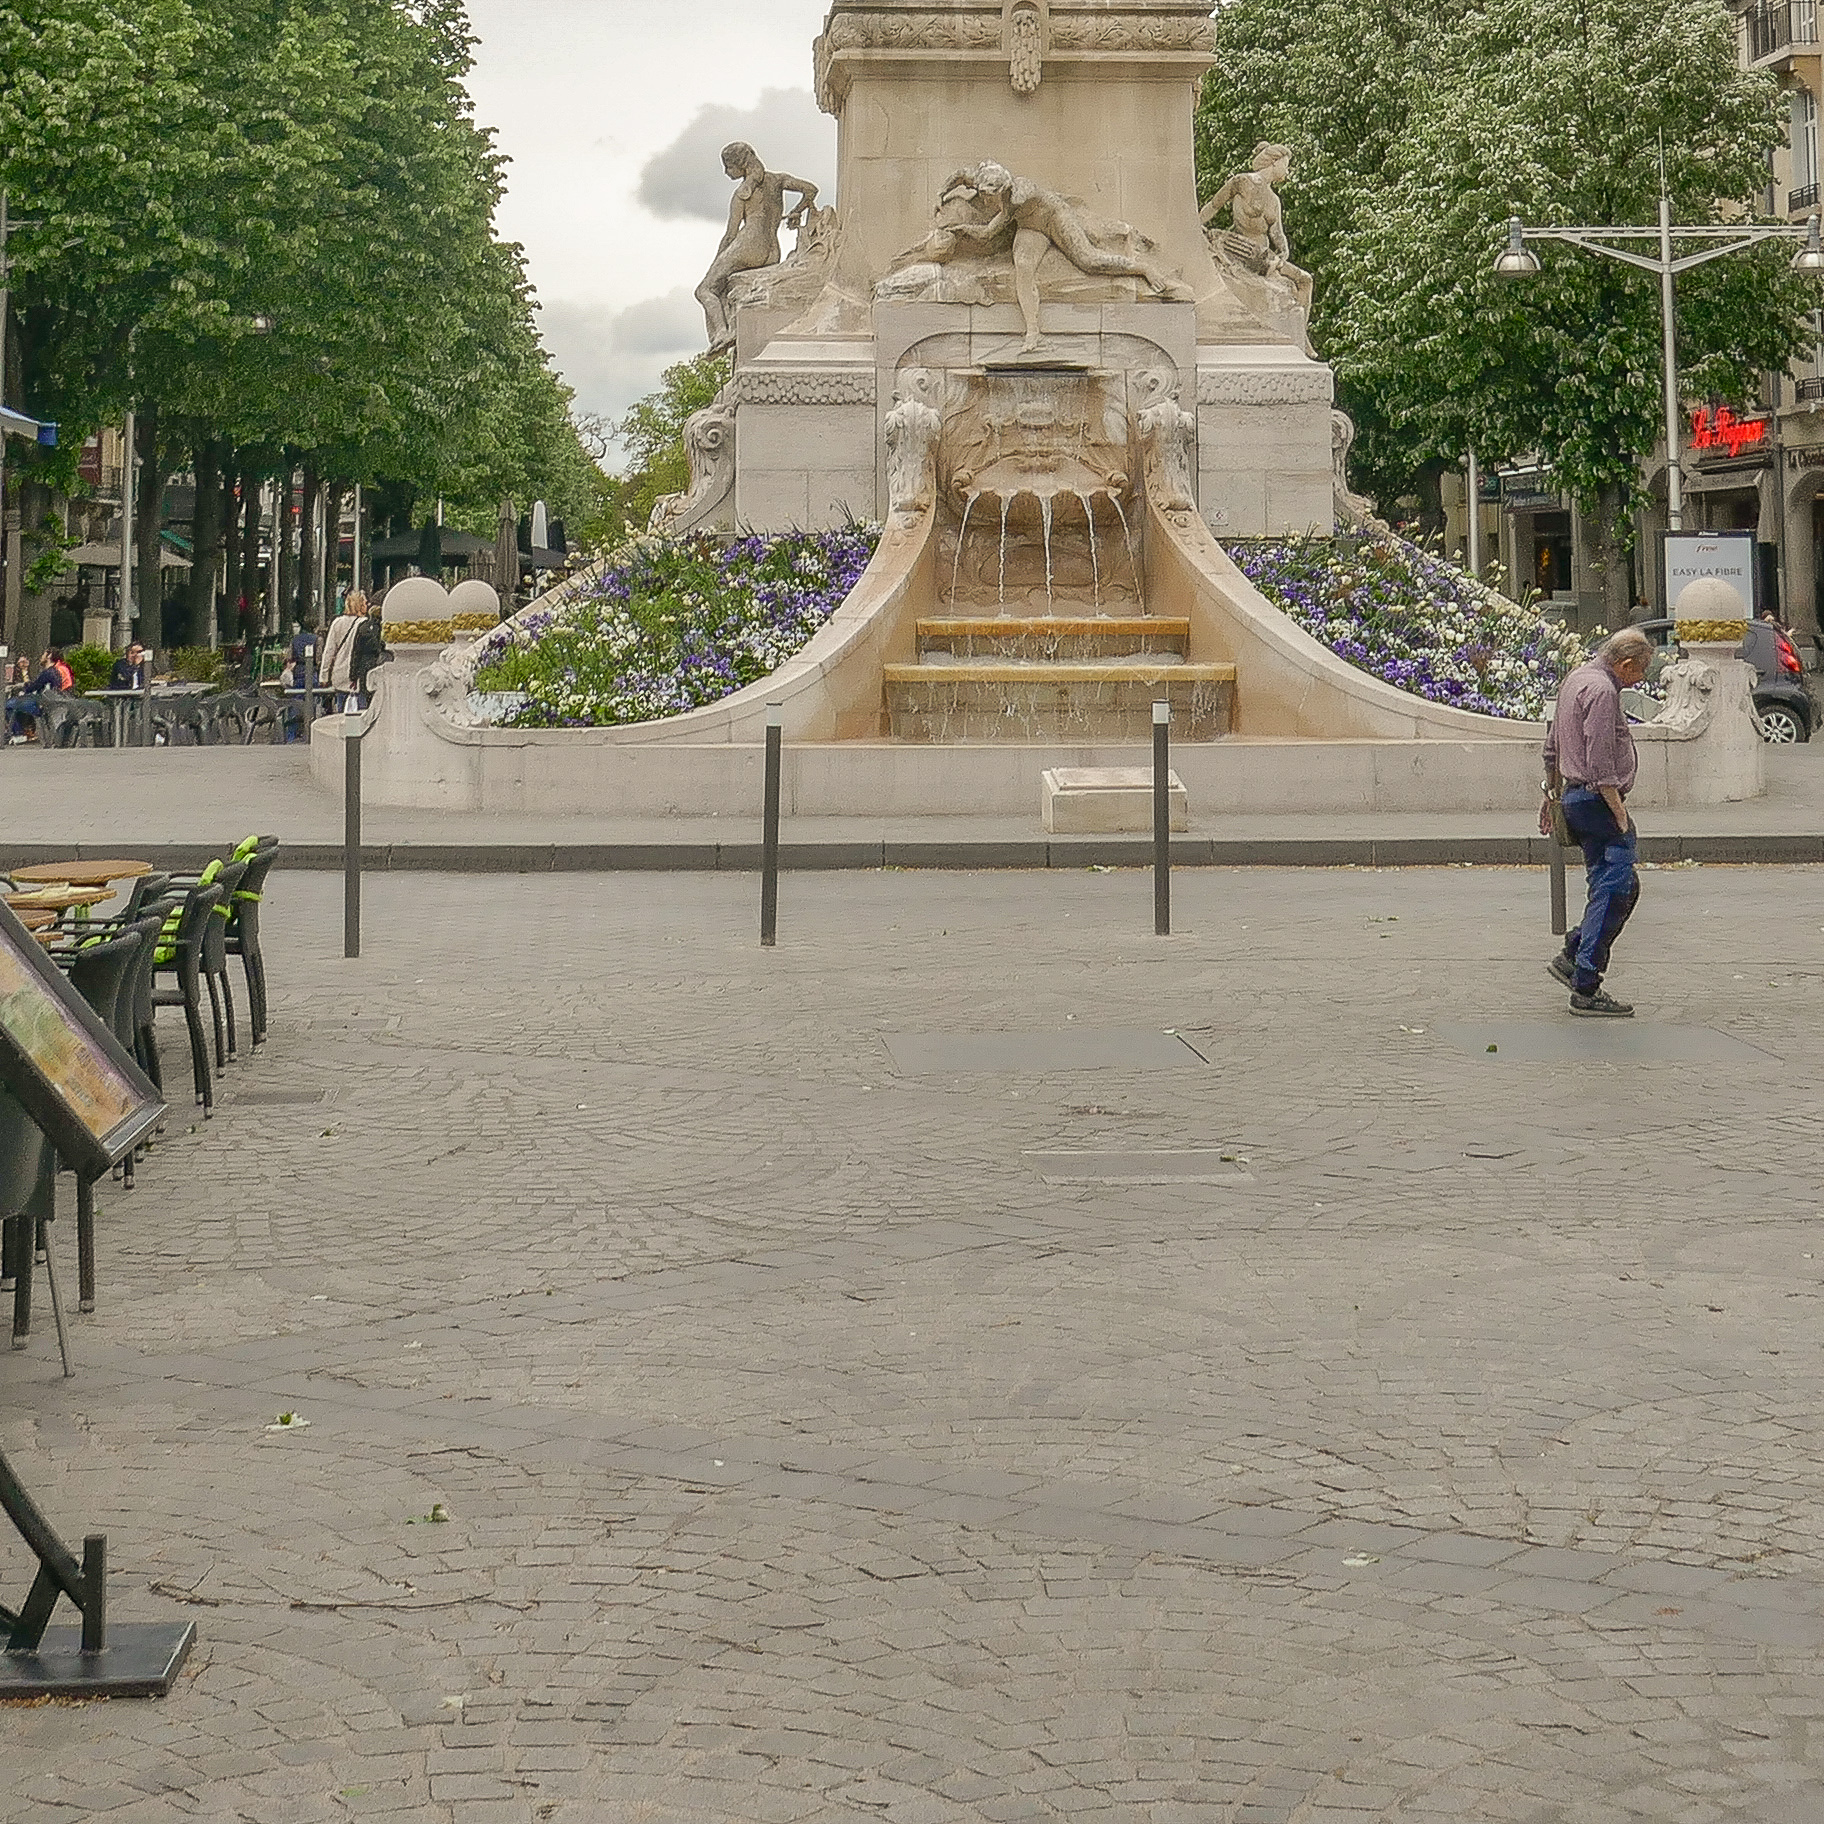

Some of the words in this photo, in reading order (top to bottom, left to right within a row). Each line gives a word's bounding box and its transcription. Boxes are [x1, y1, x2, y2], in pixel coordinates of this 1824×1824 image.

[1672, 567, 1697, 576] EASY
[1699, 567, 1714, 576] LA
[1715, 567, 1743, 576] FIBRE
